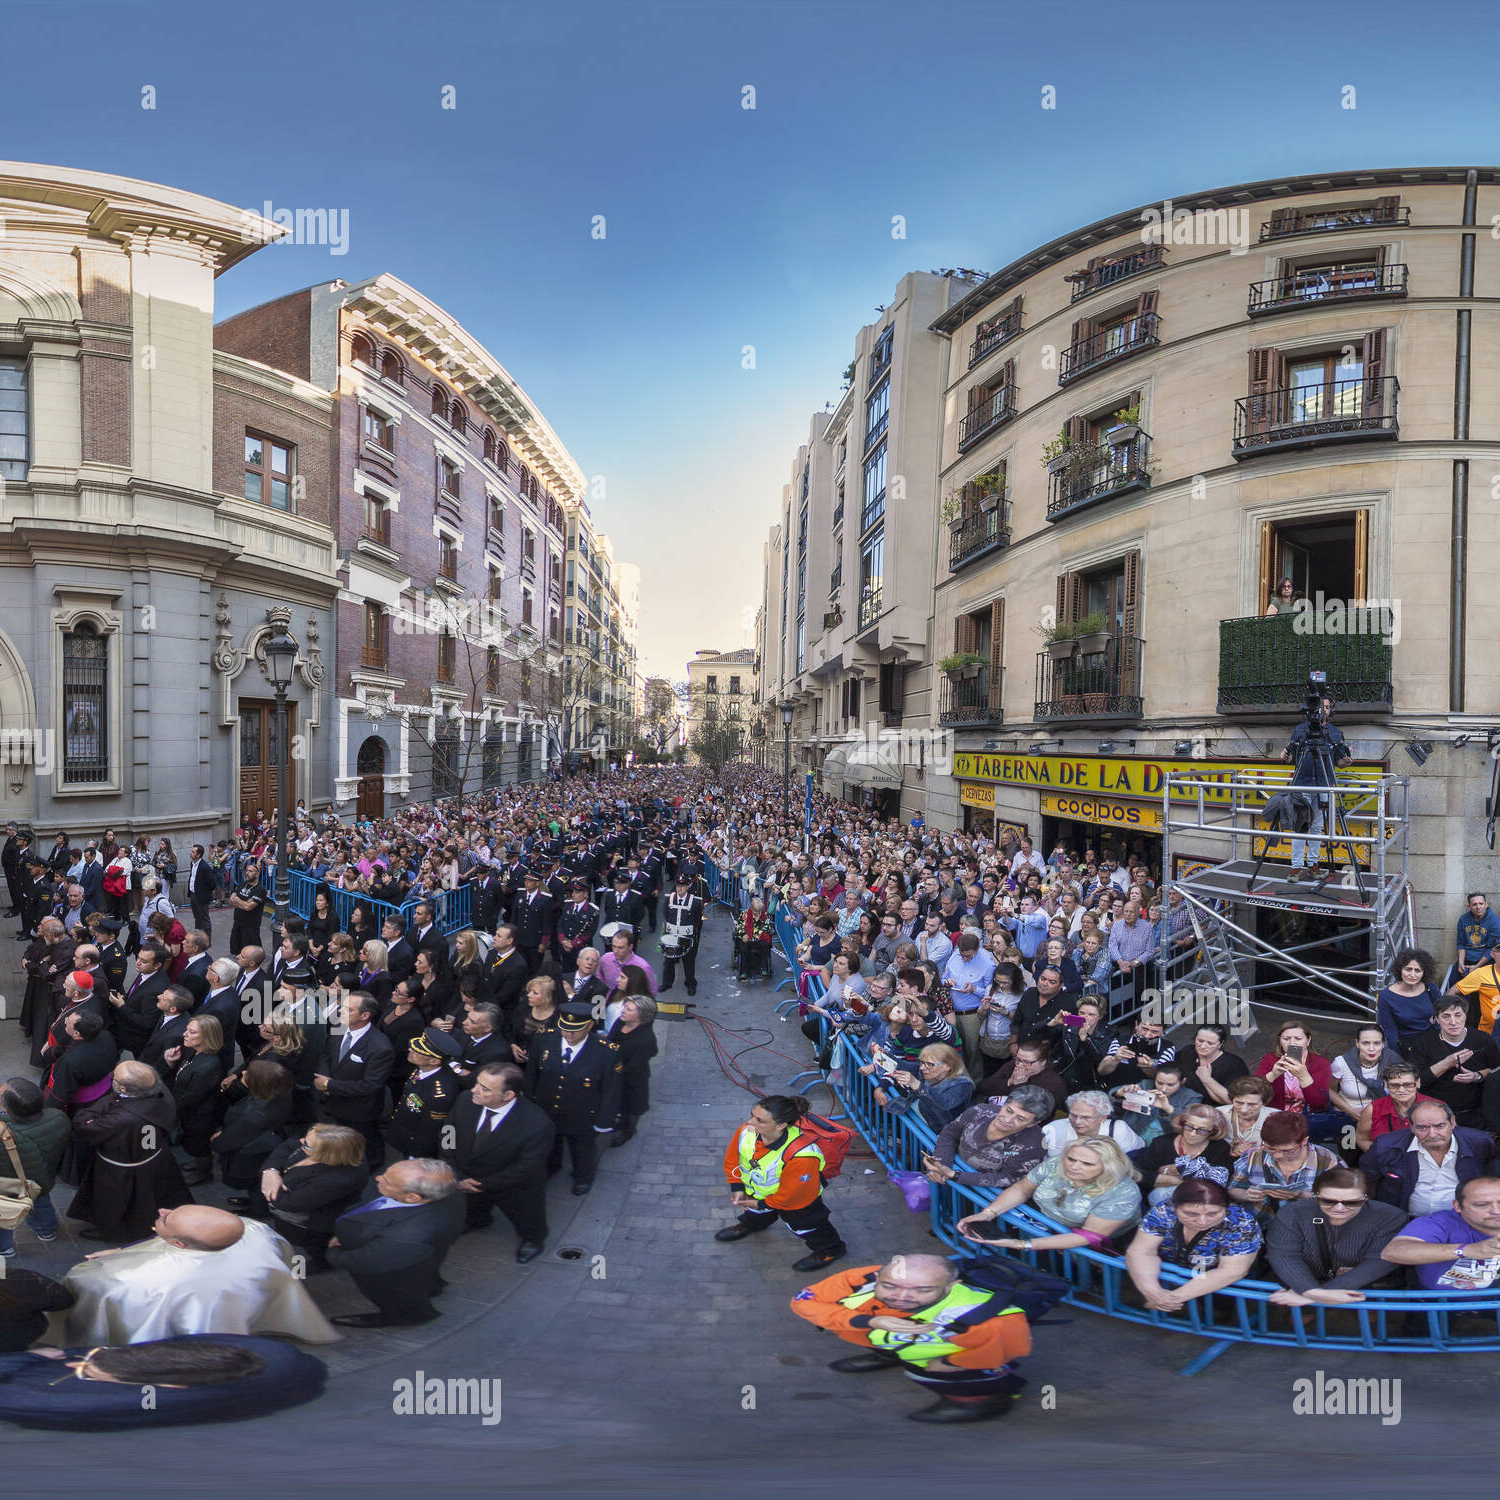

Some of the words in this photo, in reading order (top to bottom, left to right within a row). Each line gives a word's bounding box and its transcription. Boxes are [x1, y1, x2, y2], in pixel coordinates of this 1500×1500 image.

[973, 755, 1051, 783] TABERNA
[1060, 762, 1088, 787] DE
[1099, 764, 1131, 791] LA
[965, 787, 992, 803] CERVEZAS
[1057, 798, 1141, 824] COCIDOS
[1248, 898, 1291, 909] INSTANT
[1303, 905, 1332, 914] SPAN
